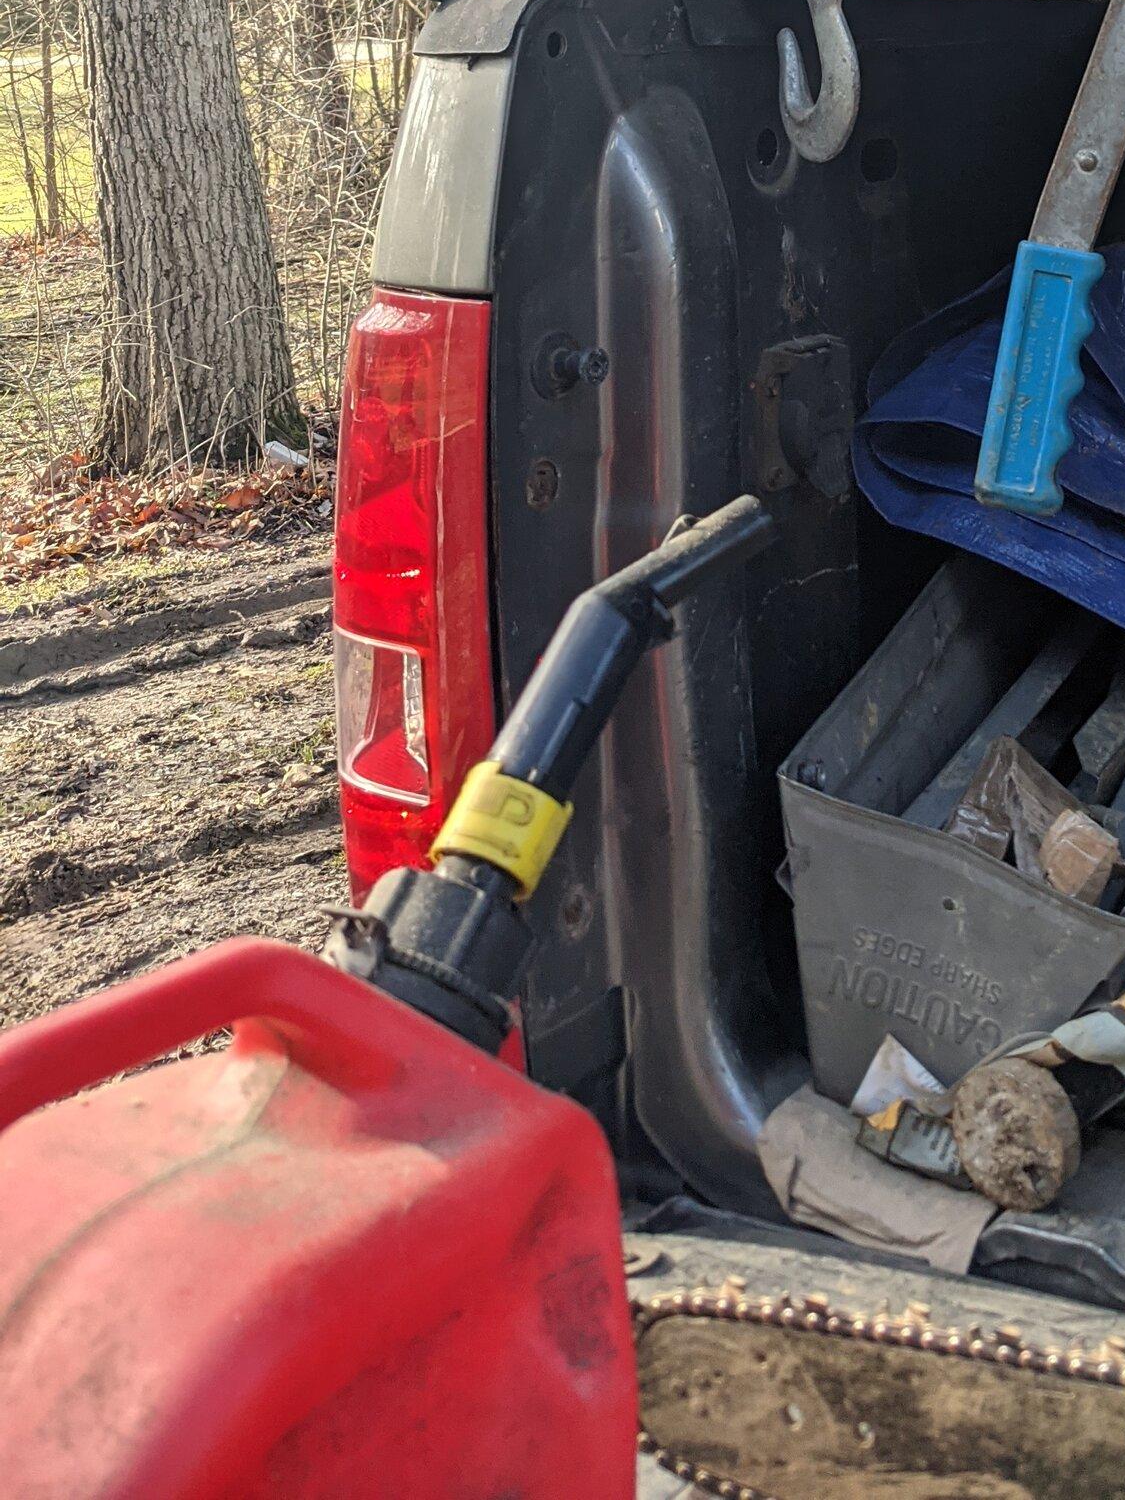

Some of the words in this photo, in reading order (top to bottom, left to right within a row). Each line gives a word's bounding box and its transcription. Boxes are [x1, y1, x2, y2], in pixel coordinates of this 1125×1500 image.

[852, 926, 926, 968] EDGES
[930, 954, 1001, 1005] SHARP
[828, 955, 1001, 1057] CAUTION
